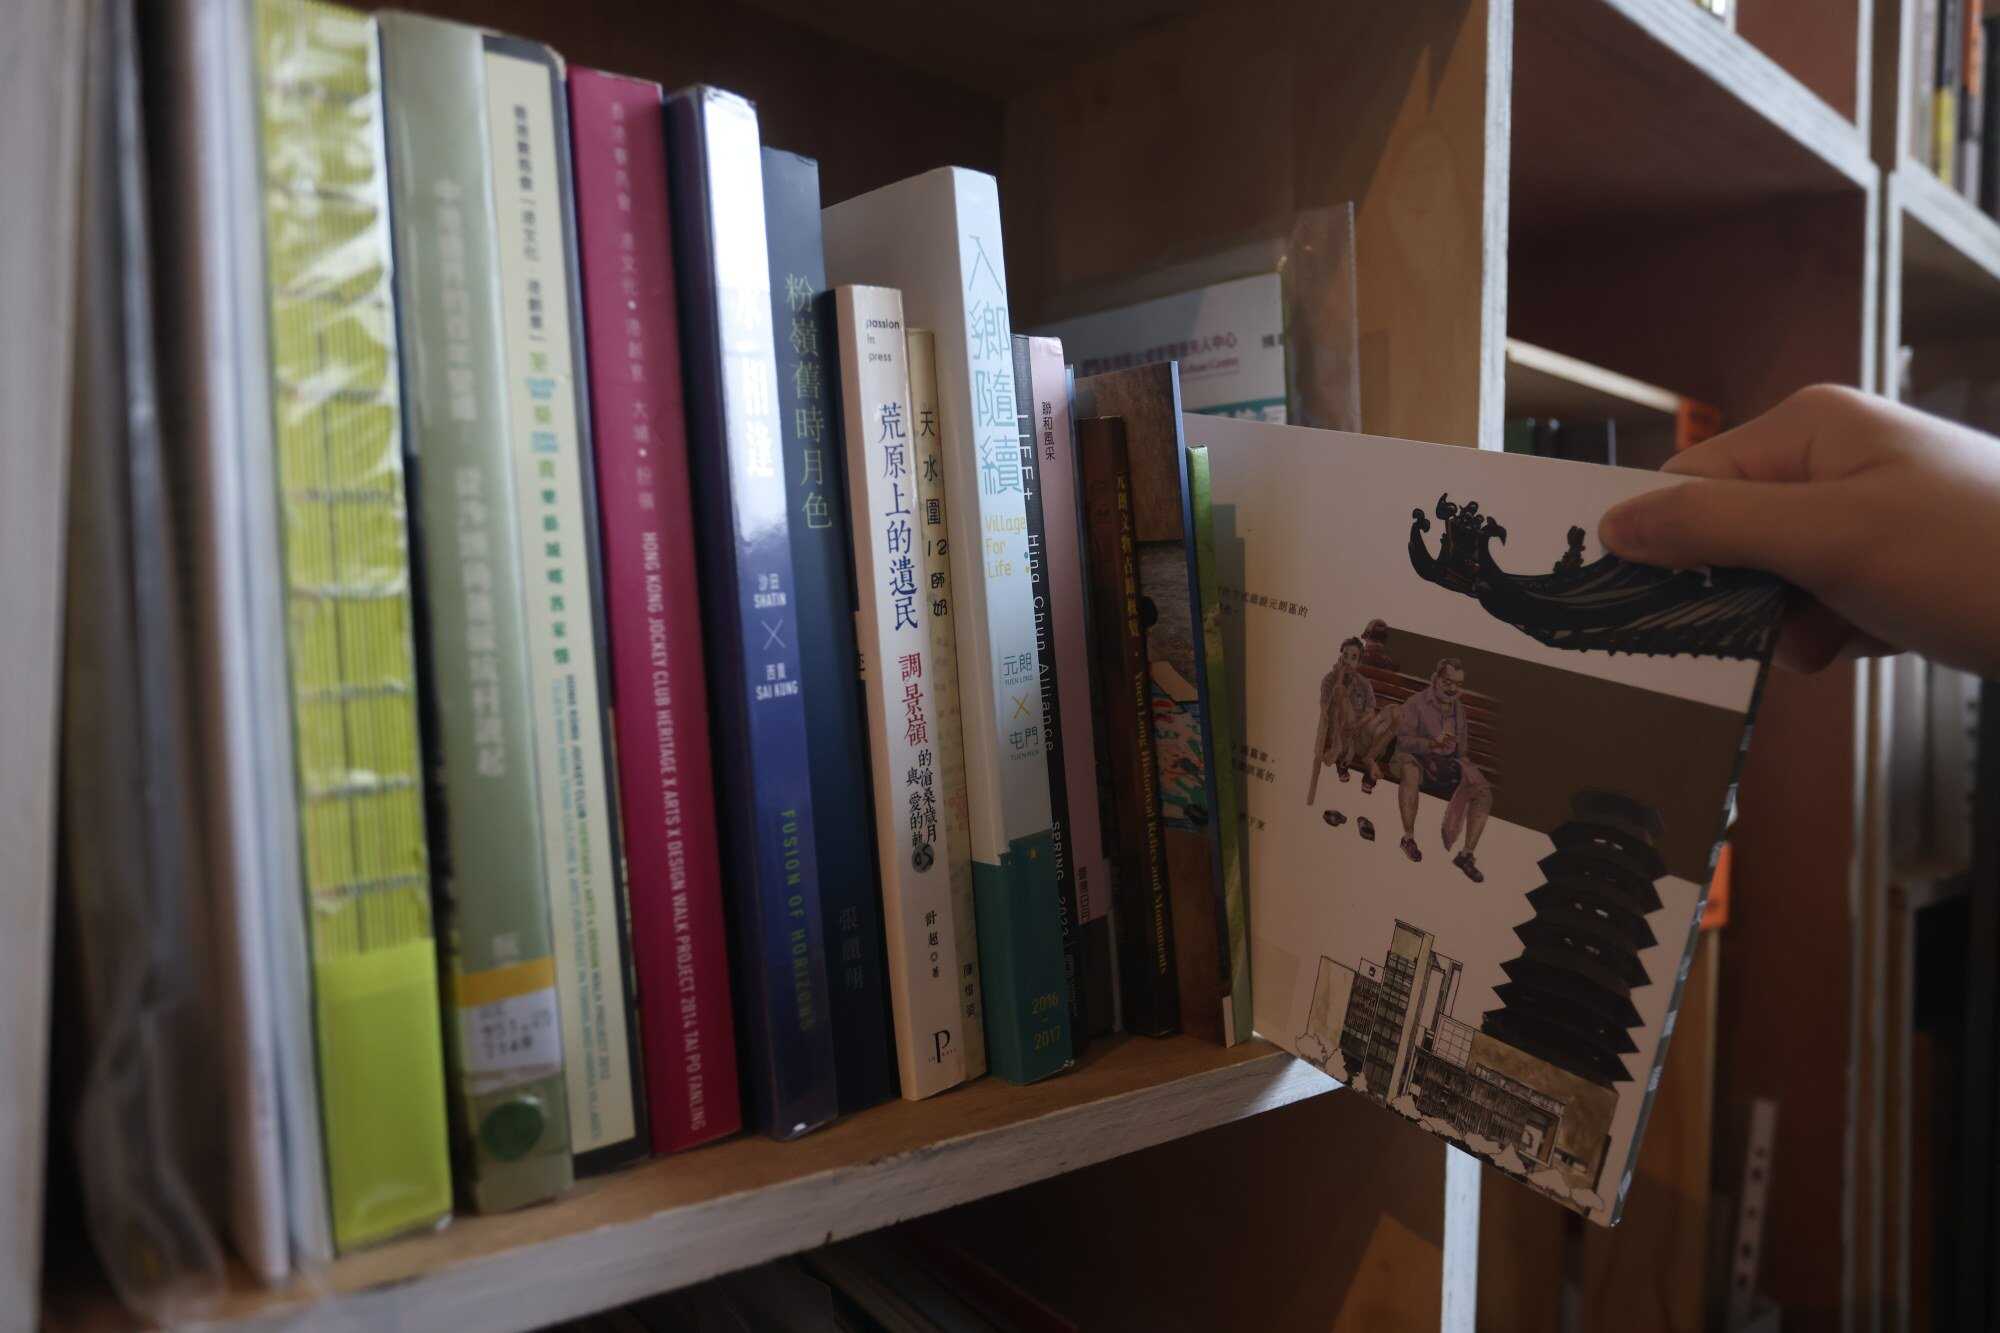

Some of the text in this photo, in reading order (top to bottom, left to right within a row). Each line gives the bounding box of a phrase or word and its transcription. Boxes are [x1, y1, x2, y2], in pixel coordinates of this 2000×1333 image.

[866, 318, 900, 331] passion
[867, 334, 875, 344] in
[869, 353, 892, 363] press
[969, 235, 1022, 496] 入鄉隨續
[785, 272, 833, 530] 粉嶺舊時月色
[879, 402, 919, 632] 荒原上的遺民
[985, 514, 1026, 535] Village
[643, 532, 658, 571] HONG
[985, 538, 1007, 555] For
[986, 560, 1013, 578] Life
[646, 574, 662, 613] KONG
[753, 592, 787, 609] SHATIN
[649, 617, 667, 668] JOCKEY
[1033, 596, 1048, 651] Chun
[654, 670, 671, 706] CLUB
[756, 680, 799, 701] SAI KUNG
[899, 652, 928, 747] 調景嶺
[1038, 662, 1055, 753] Alliance
[657, 709, 677, 775] HERITAGE
[1009, 726, 1038, 750] 屯門
[665, 777, 678, 789] X
[665, 790, 680, 826] ARTS
[668, 829, 681, 840] X
[1050, 821, 1065, 881] SPRING
[669, 841, 687, 892] DESIGN
[672, 894, 690, 933] WALK
[780, 808, 813, 1032] FUSION OF HORIZONS
[675, 935, 695, 995] PROJECT
[681, 996, 698, 1029] 2014
[686, 1053, 702, 1074] PO
[687, 1074, 706, 1132] FANLING
